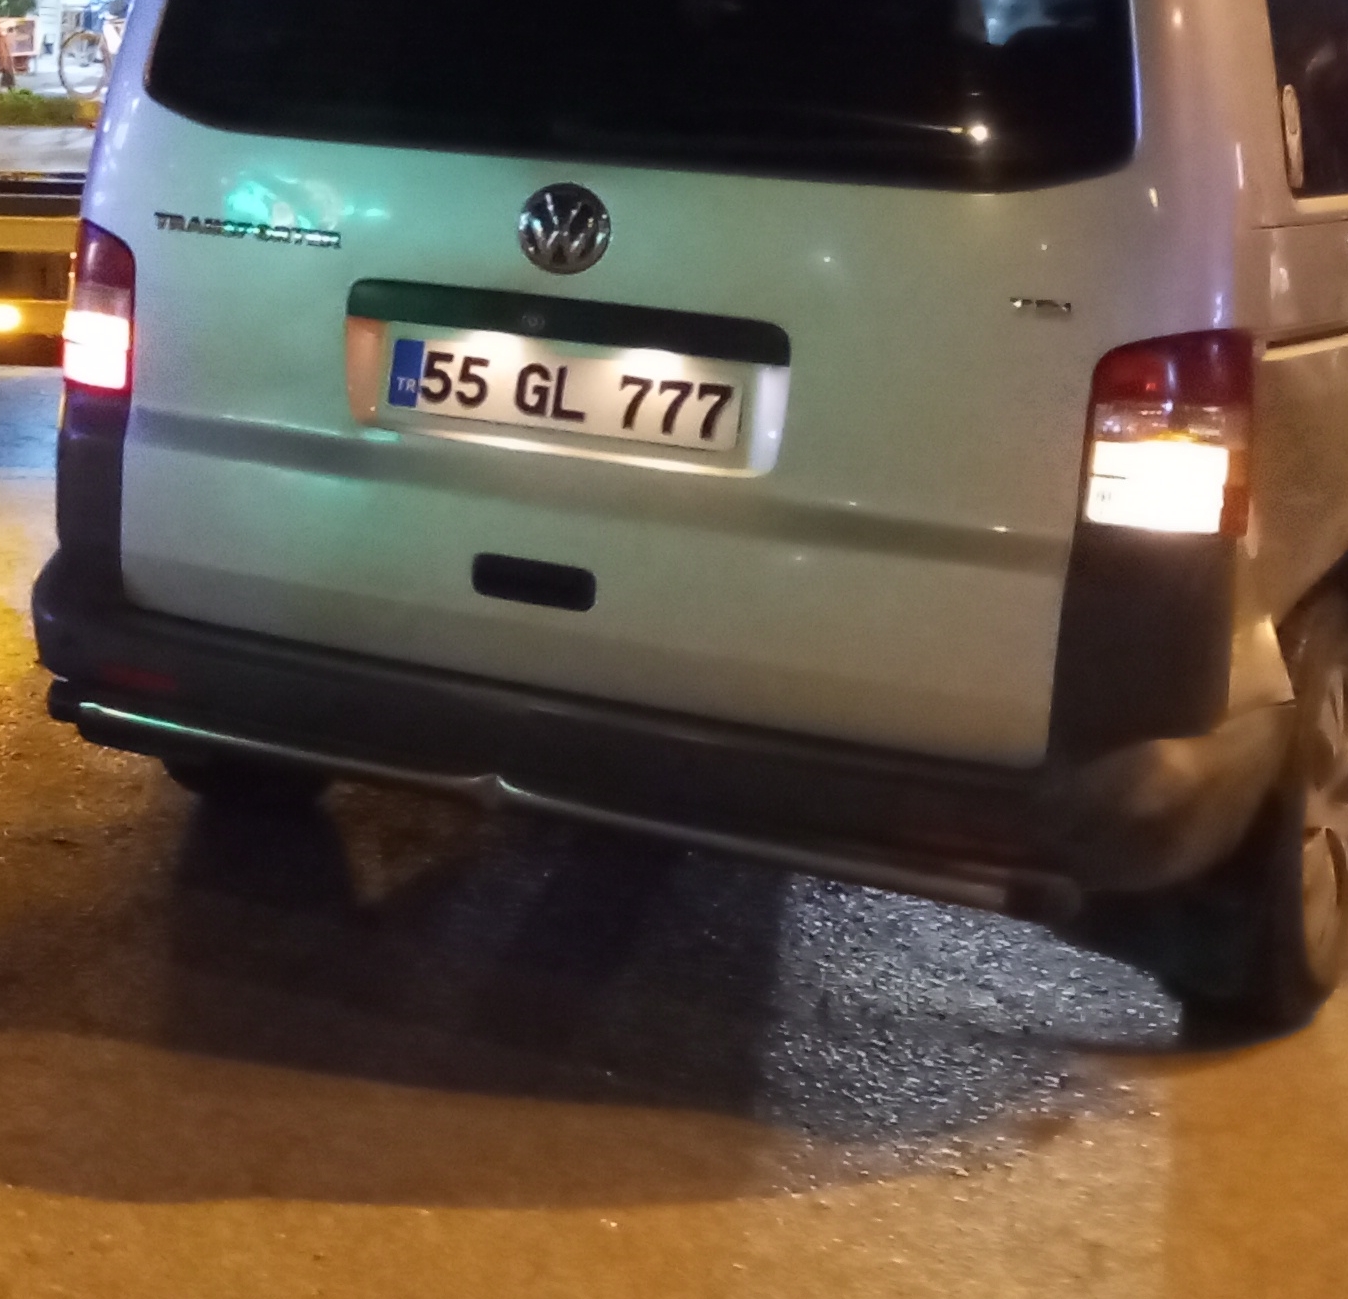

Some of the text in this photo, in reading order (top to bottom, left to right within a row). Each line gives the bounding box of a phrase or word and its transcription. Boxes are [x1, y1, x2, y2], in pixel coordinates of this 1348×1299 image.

[396, 376, 417, 394] TR
[420, 350, 735, 440] 55 GL 777
